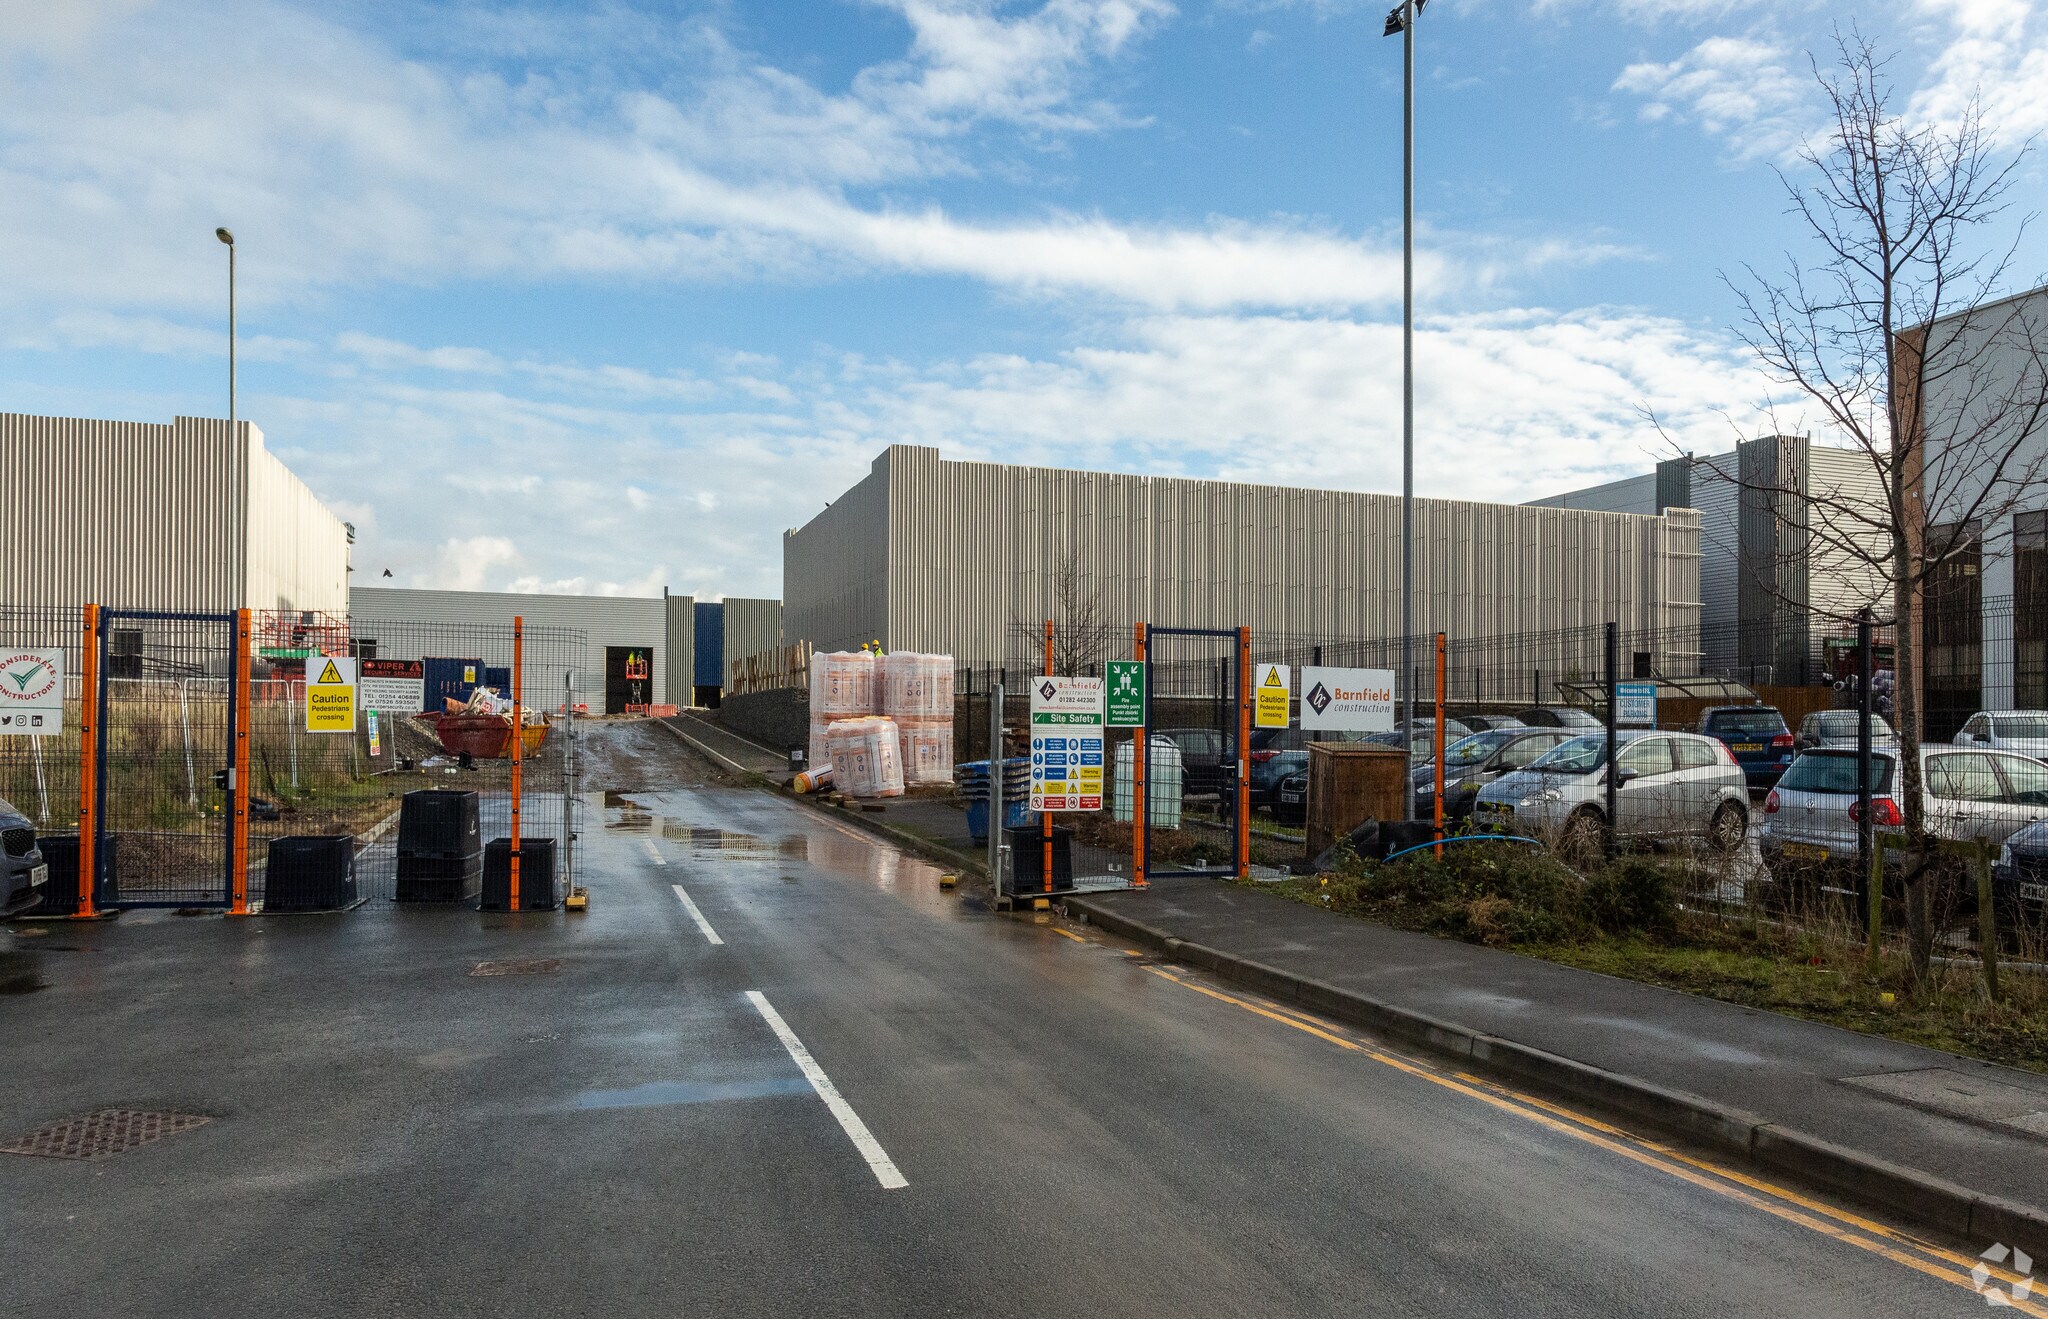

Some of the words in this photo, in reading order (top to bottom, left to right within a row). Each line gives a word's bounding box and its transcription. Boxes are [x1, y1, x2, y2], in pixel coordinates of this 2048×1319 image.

[0, 655, 57, 676] ONSIDERATE
[377, 662, 405, 670] VIPER
[0, 680, 56, 700] ONSTRUCTORS
[1334, 687, 1390, 702] Barnfield
[312, 694, 349, 703] Caution
[1260, 694, 1286, 704] Caution
[1334, 702, 1391, 714] construction
[1050, 713, 1066, 723] Site
[1069, 714, 1095, 724] Safety
